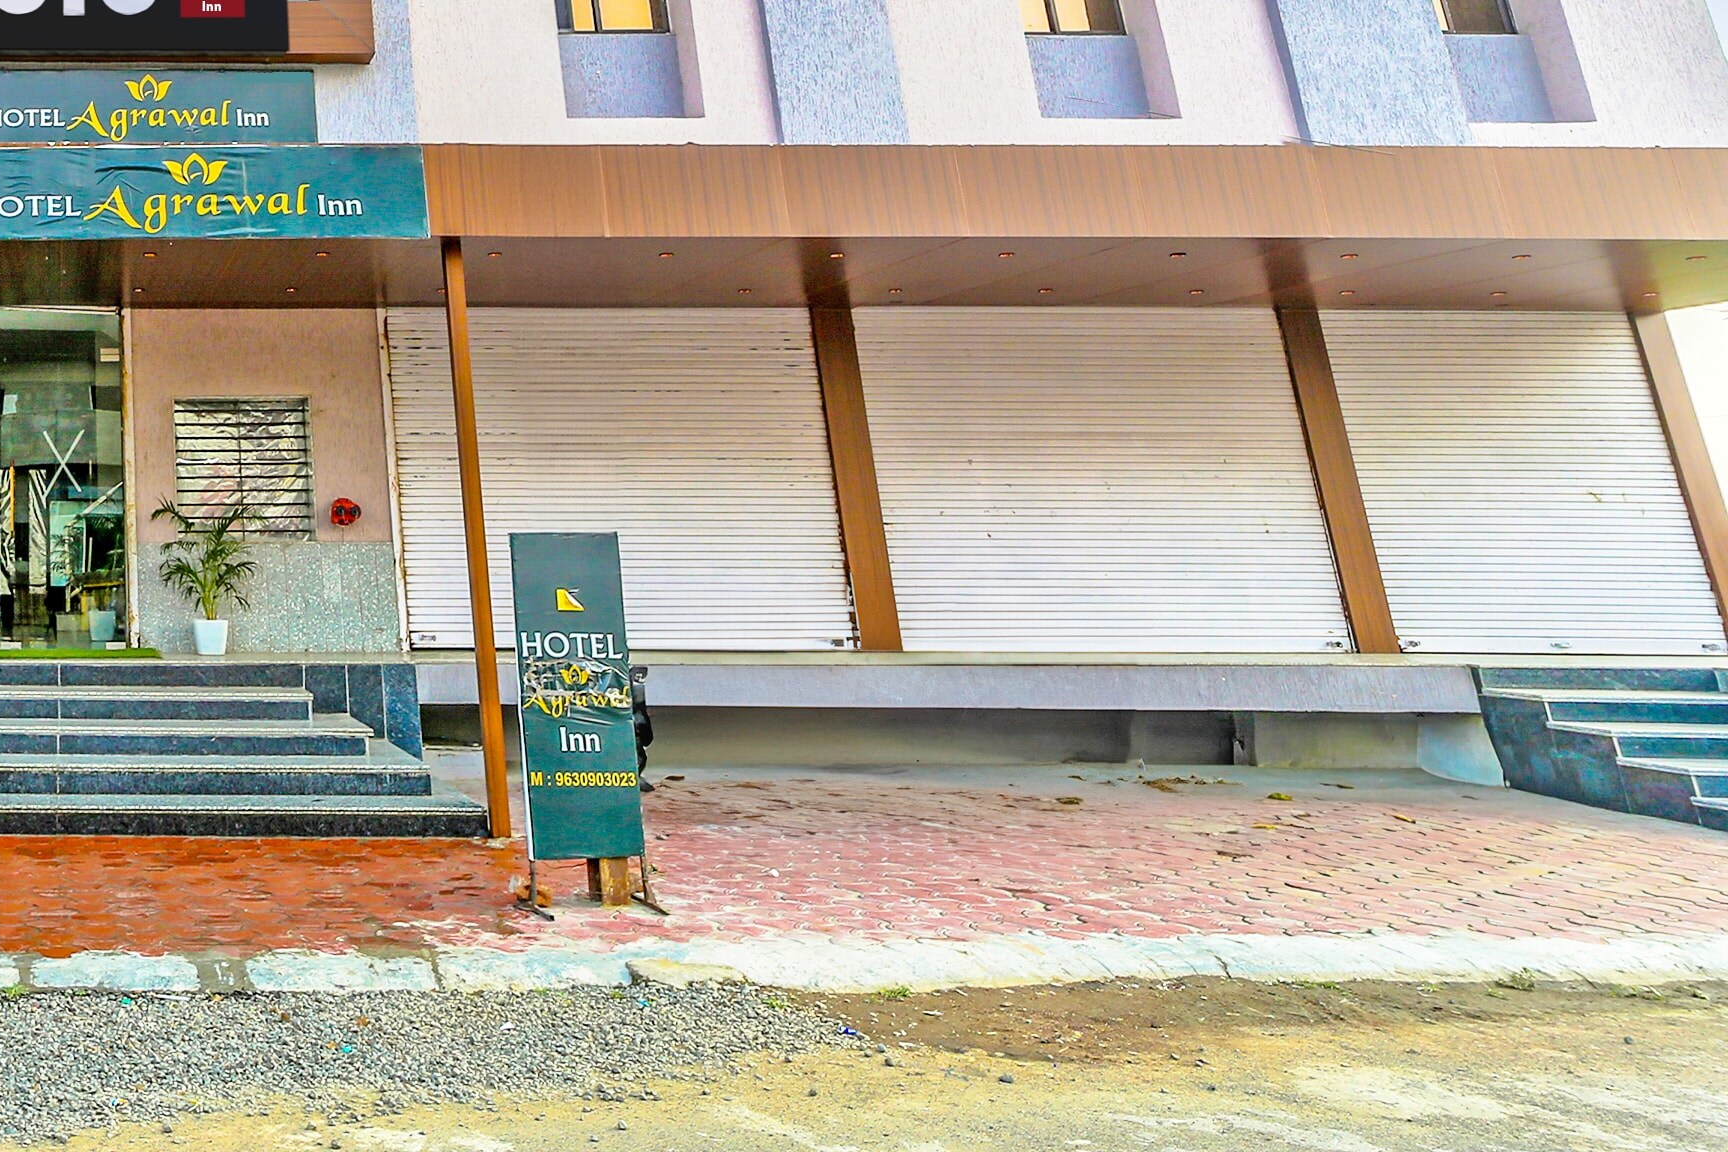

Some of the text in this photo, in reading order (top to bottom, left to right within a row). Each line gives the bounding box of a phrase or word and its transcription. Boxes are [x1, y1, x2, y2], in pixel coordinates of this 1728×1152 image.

[201, 0, 222, 12] Inn
[66, 100, 232, 142] Agrawal
[236, 108, 270, 128] Inn
[82, 183, 311, 234] Agrawal
[317, 194, 363, 217] Inn
[520, 631, 624, 660] HOTEL
[559, 726, 602, 753] Inn
[555, 771, 638, 787] 9630903023
